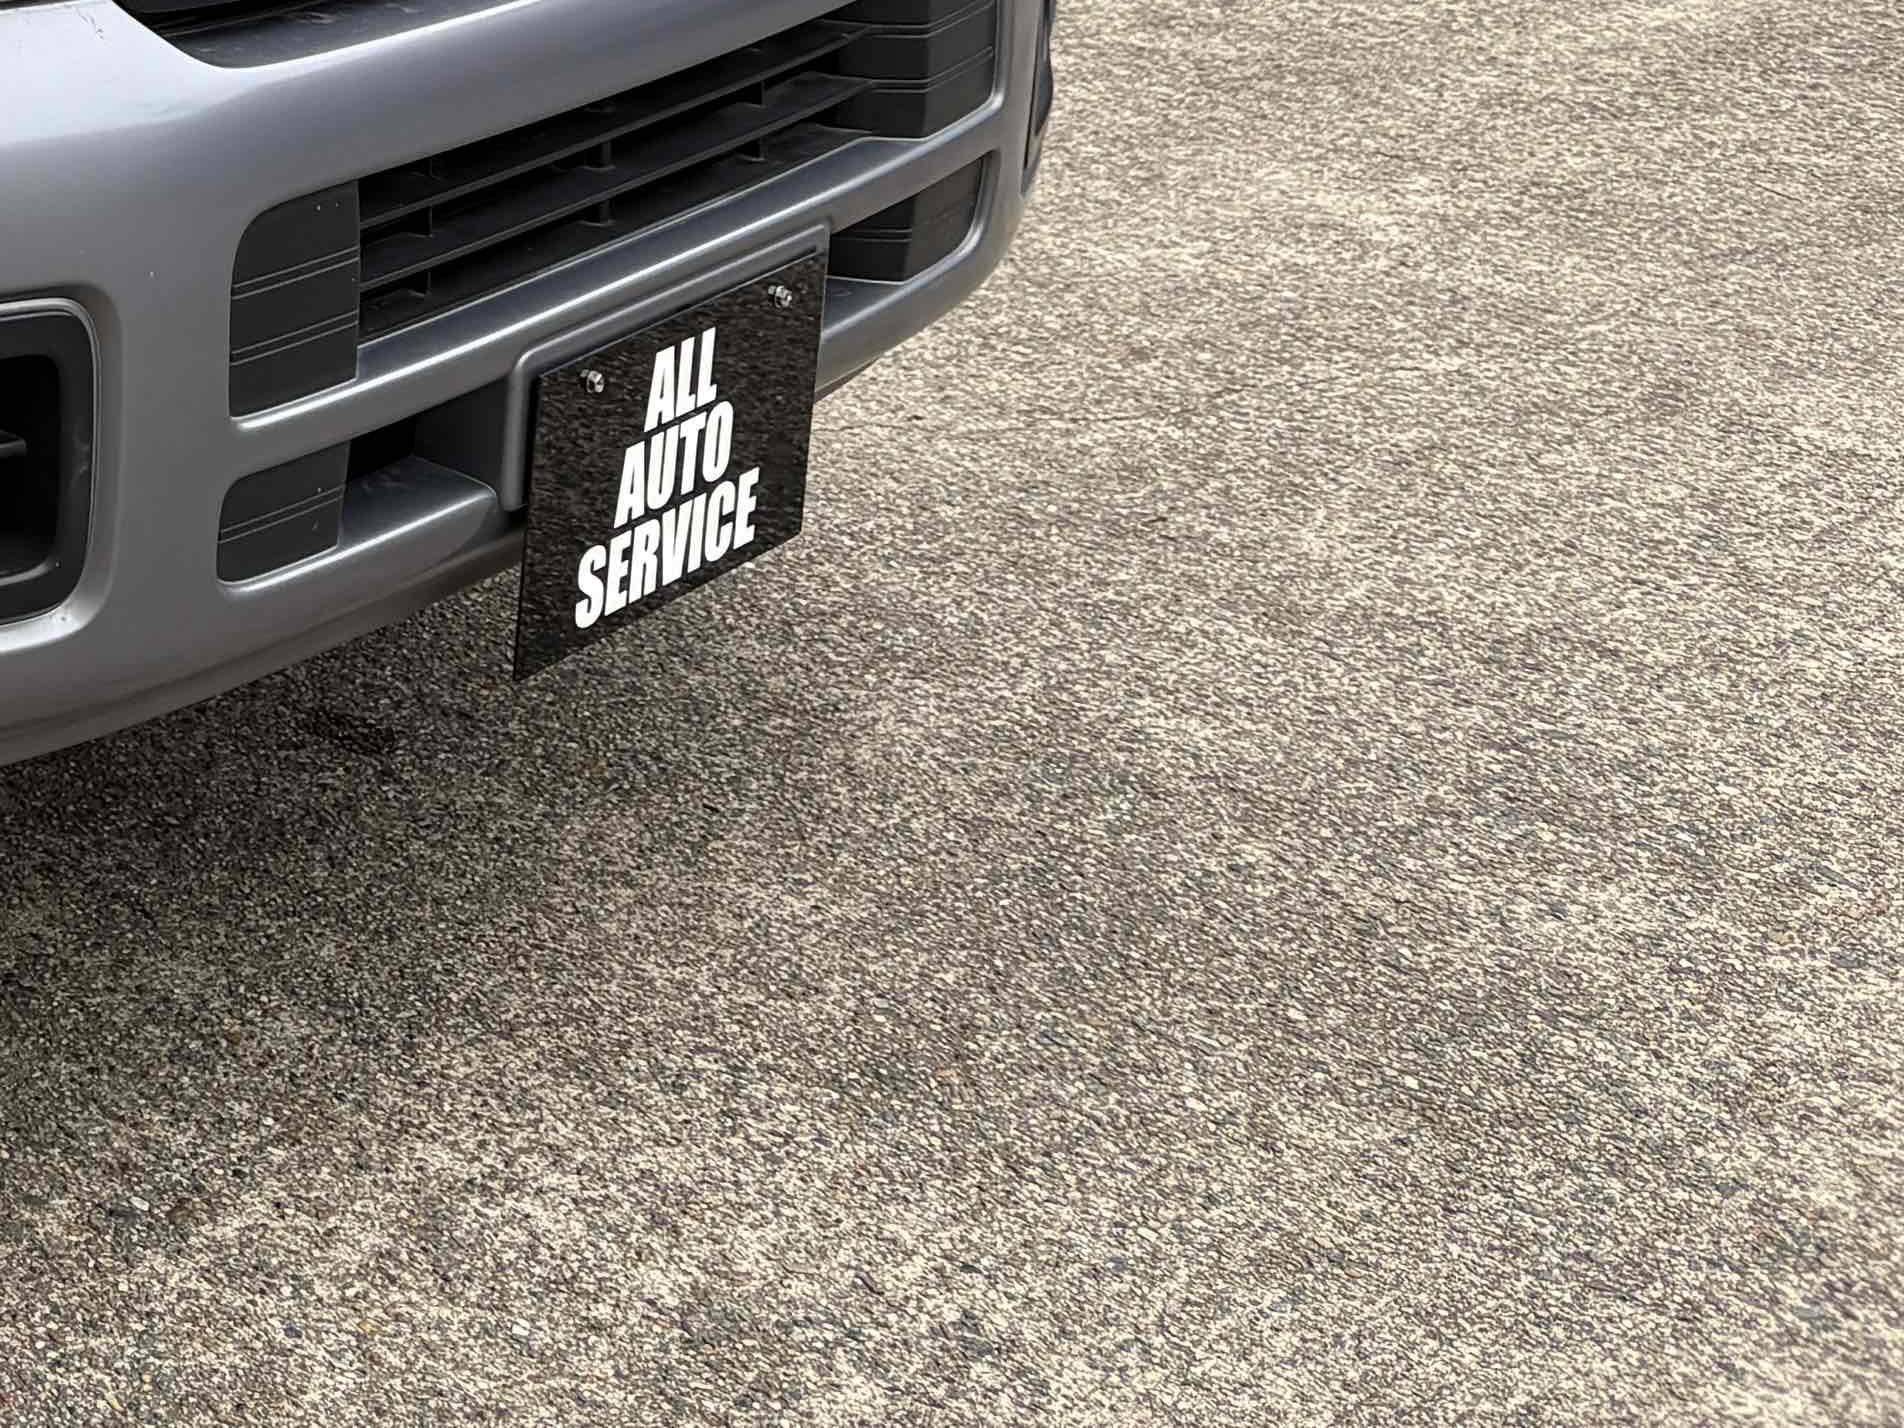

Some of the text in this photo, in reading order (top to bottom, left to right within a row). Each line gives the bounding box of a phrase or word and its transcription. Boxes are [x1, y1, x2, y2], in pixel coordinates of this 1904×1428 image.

[644, 327, 717, 432] ALL
[614, 400, 734, 529] AUTO
[574, 466, 760, 630] SERVICE
